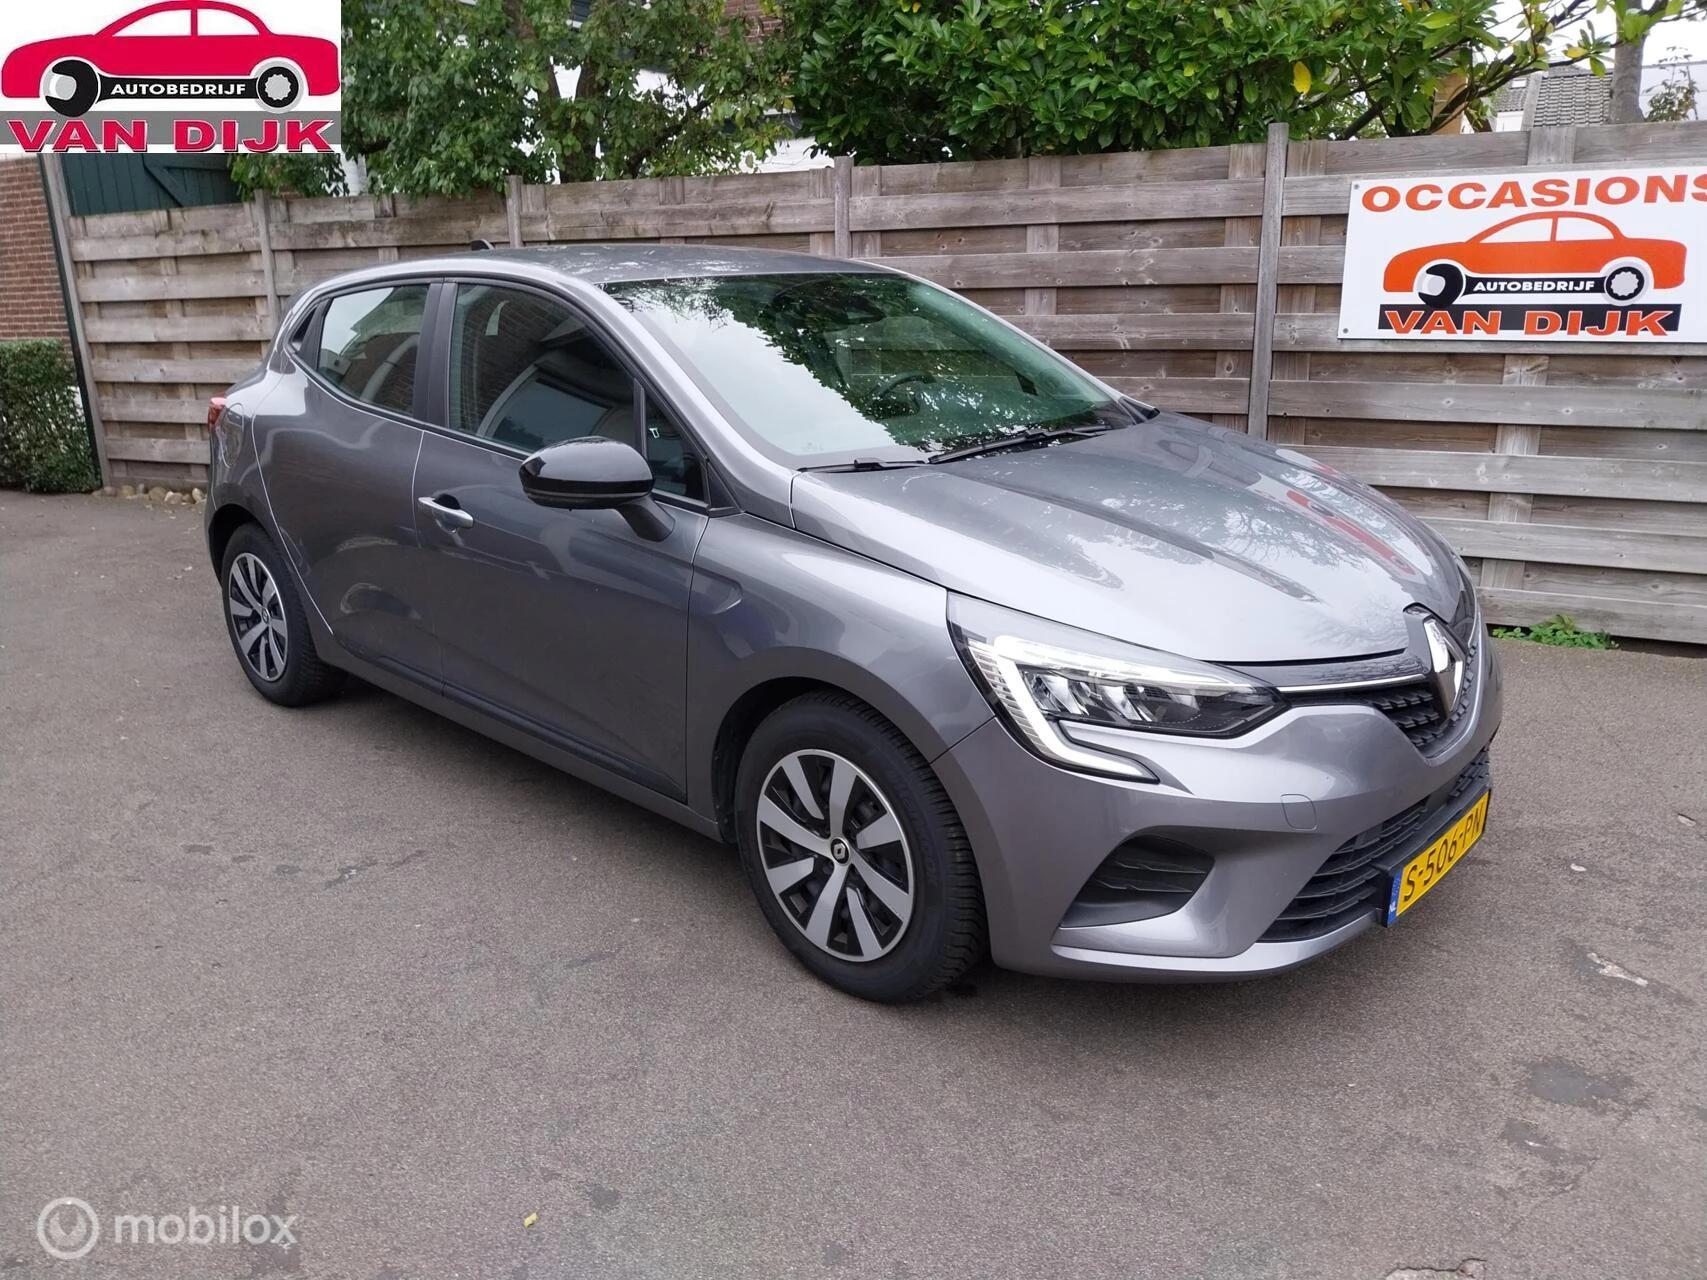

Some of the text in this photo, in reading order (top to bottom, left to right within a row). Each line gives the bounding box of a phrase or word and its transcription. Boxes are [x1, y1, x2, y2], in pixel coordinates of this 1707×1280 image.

[1473, 280, 1596, 293] AUTOBEDRIJF
[1385, 310, 1673, 337] VAN DIJK
[1403, 801, 1484, 903] S-506-PN
